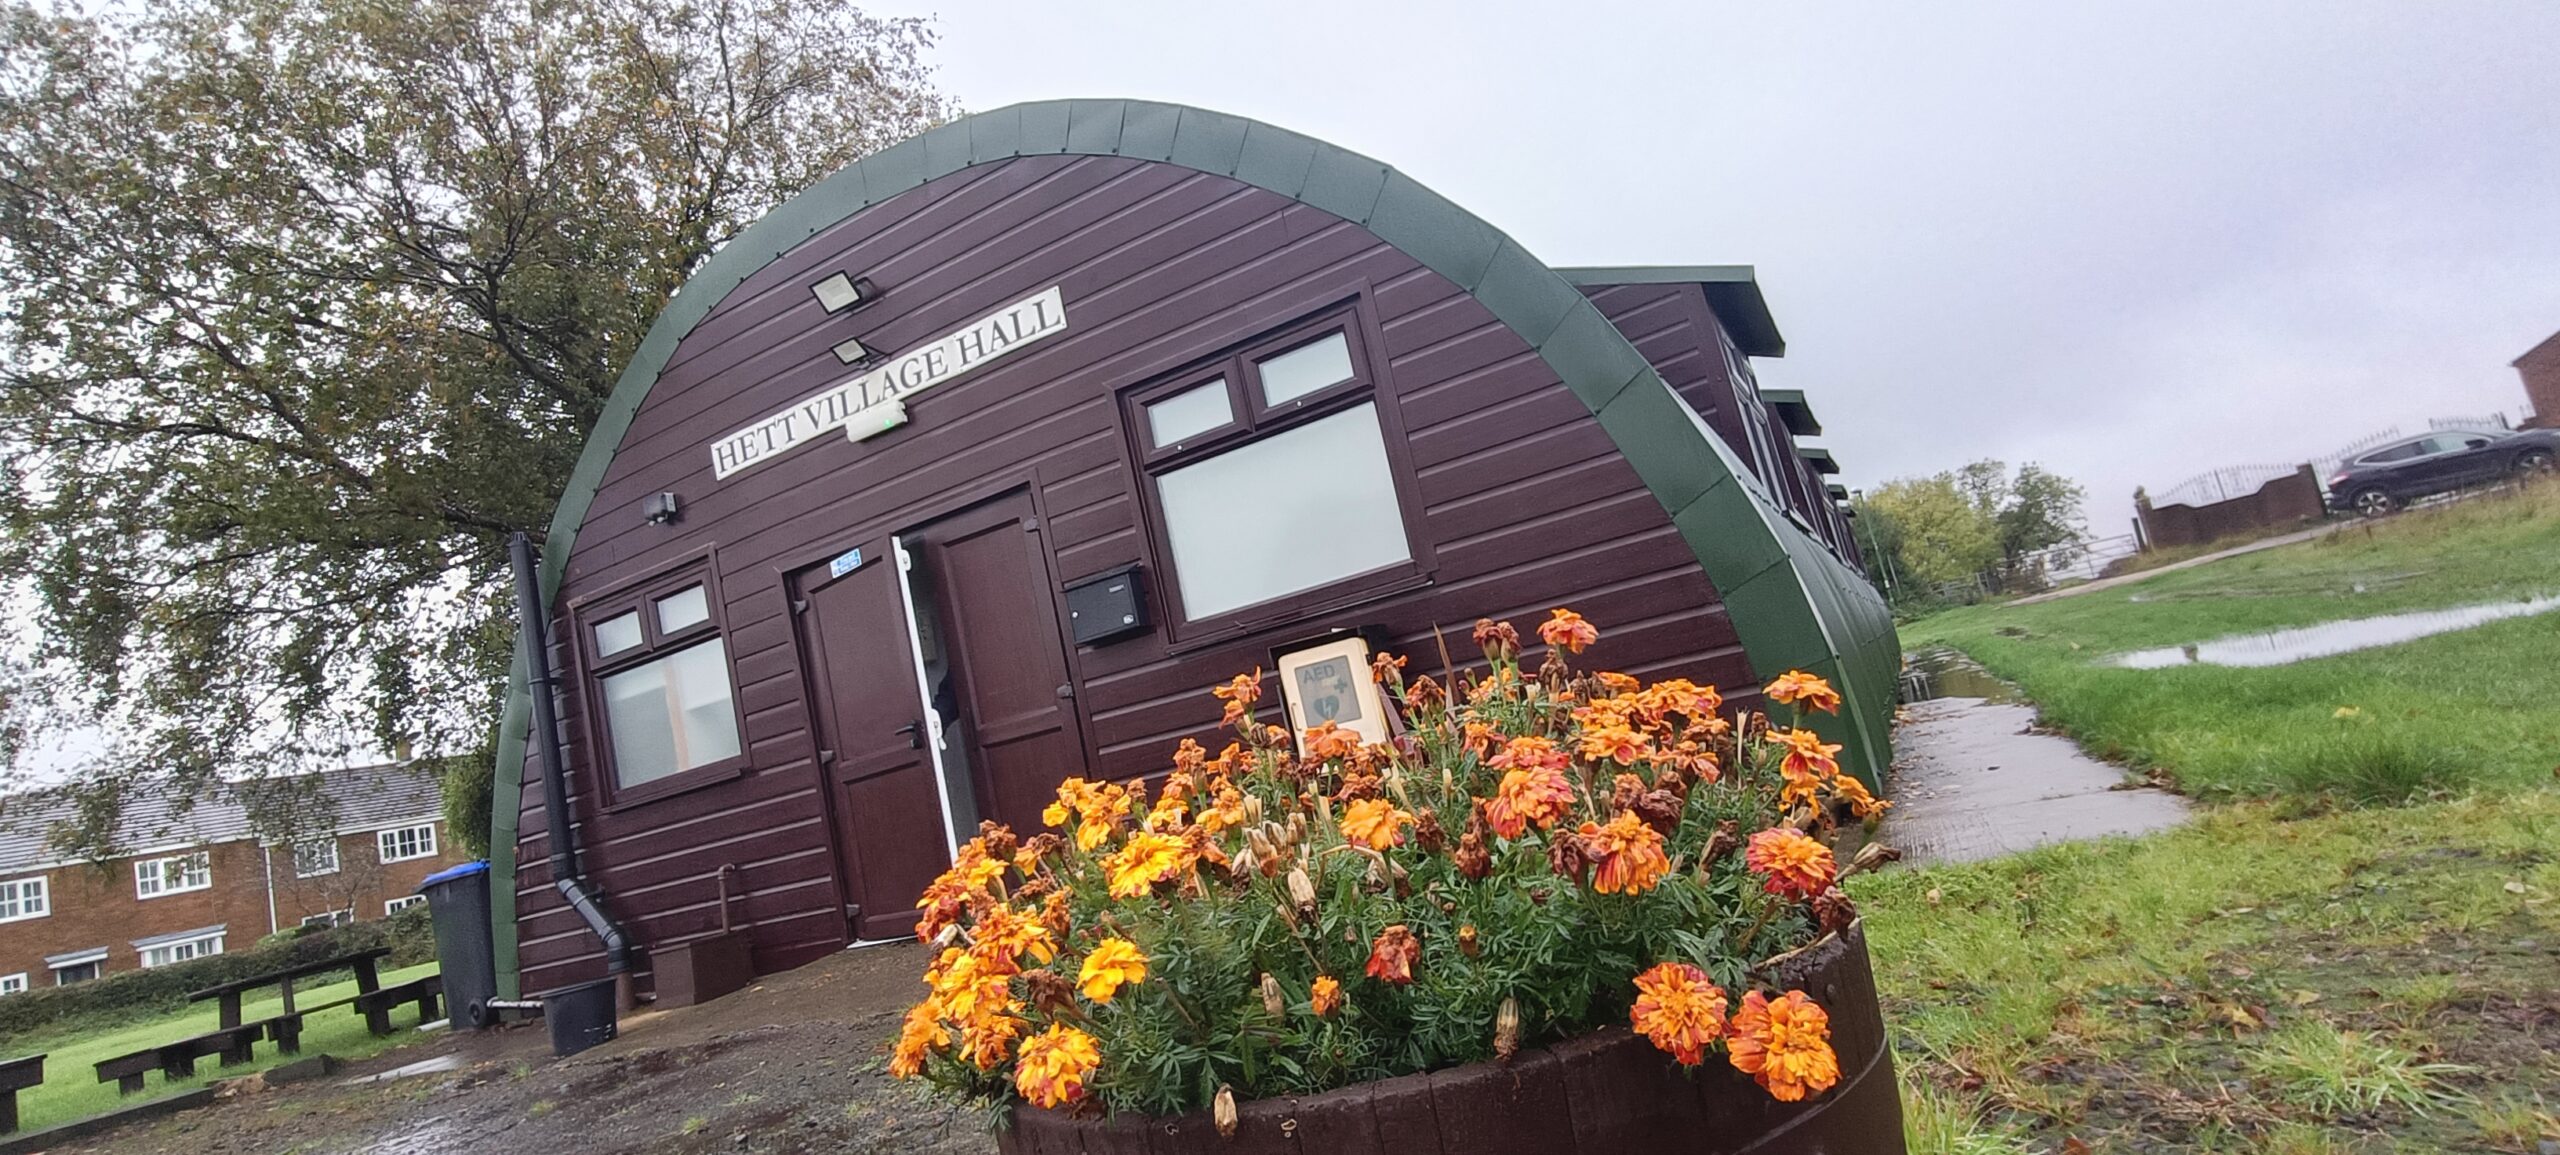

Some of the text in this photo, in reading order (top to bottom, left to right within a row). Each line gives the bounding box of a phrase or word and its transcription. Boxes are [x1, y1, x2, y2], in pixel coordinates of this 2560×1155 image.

[714, 298, 1062, 474] HETT VILLAGE HALL
[1303, 664, 1335, 684] AED
